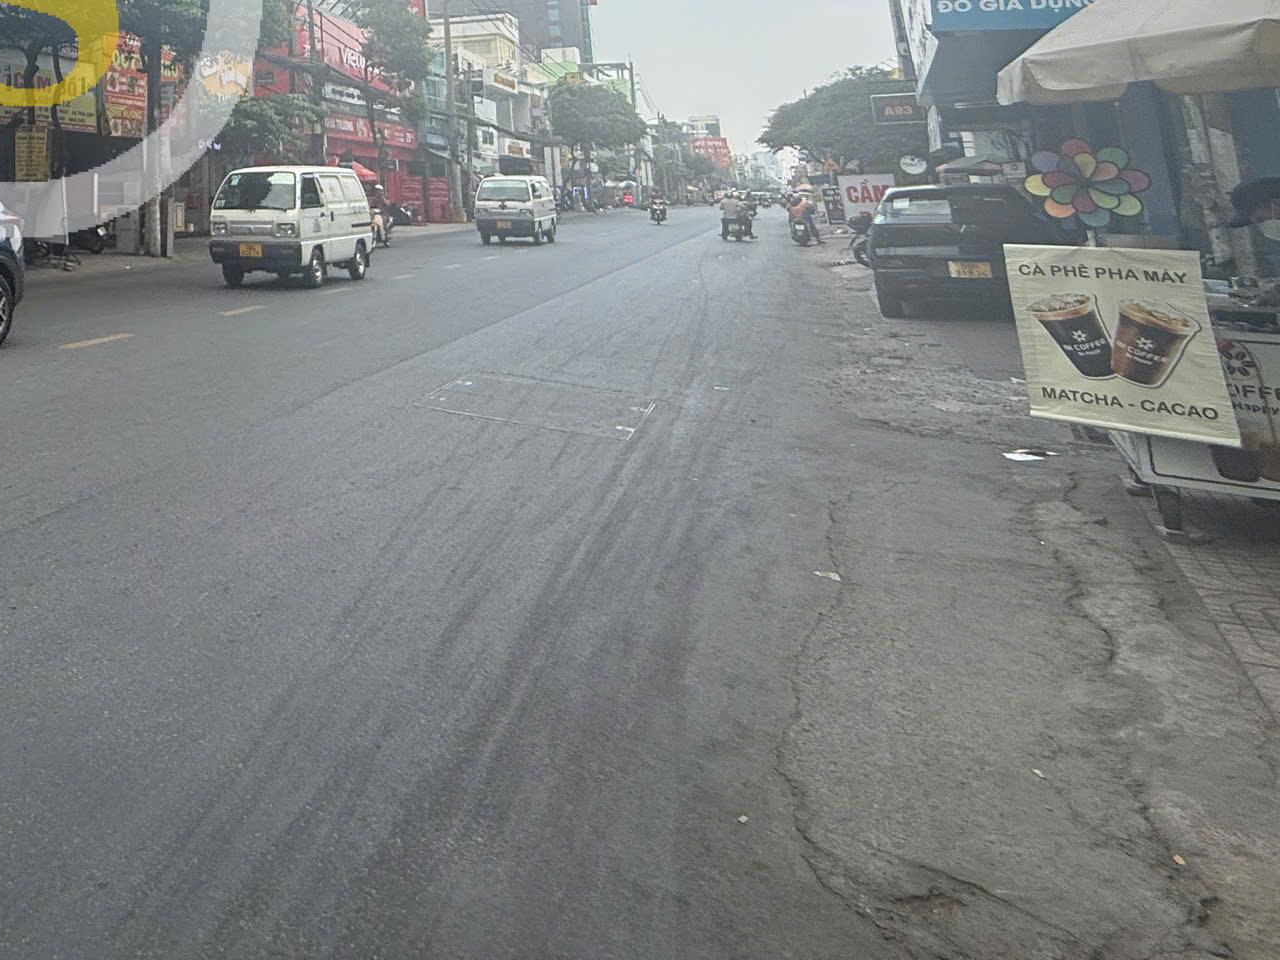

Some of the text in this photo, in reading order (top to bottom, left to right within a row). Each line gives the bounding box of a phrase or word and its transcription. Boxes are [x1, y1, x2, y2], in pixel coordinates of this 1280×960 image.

[1018, 262, 1188, 284] CÀ PHÊ PHA MÁY
[1041, 387, 1124, 409] MATCHA
[1140, 399, 1219, 420] CACAO
